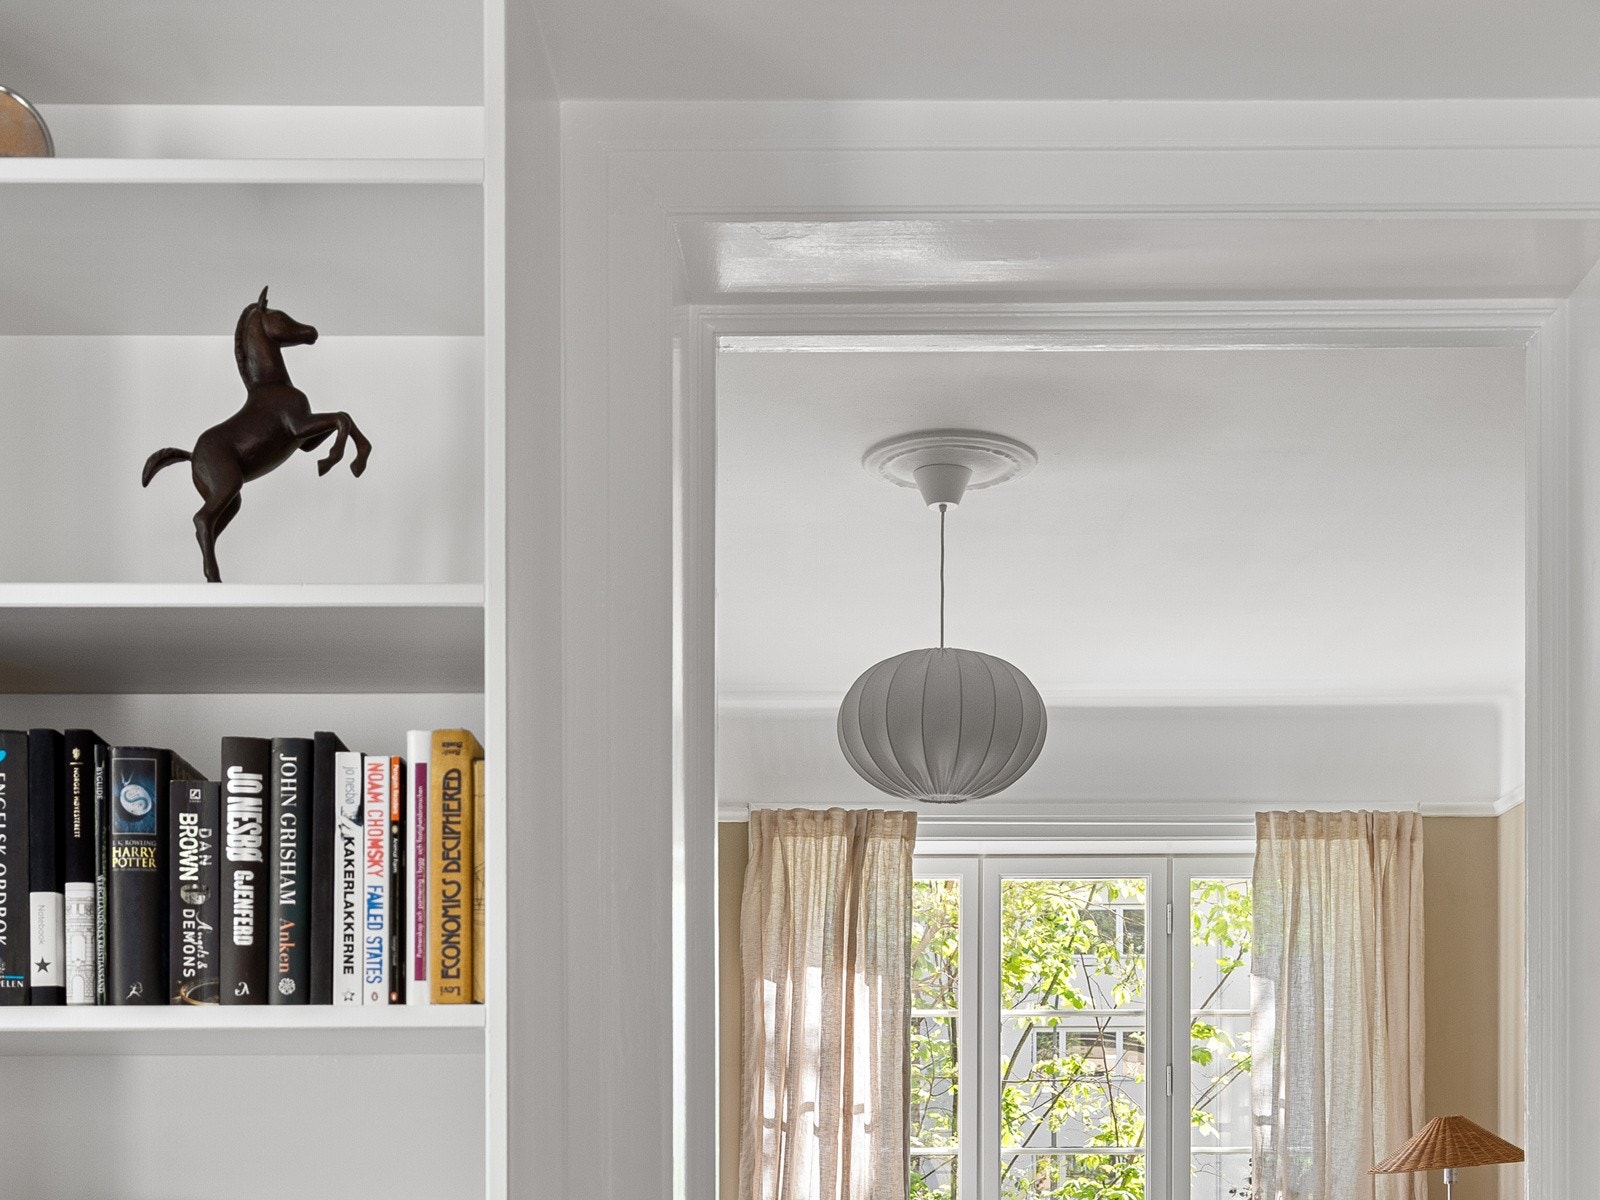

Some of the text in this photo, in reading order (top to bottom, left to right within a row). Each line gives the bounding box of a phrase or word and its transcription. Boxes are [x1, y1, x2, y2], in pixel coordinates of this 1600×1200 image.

[226, 765, 263, 863] JO NESBØ
[342, 766, 356, 805] jo nesbø
[112, 846, 157, 858] HARRY
[178, 812, 199, 881] BROWN
[199, 828, 213, 866] DAN
[367, 763, 385, 878] NOAM CHOMSKY
[112, 857, 157, 868] POTTER
[278, 753, 298, 973] JOHN GRISHAM Anken
[441, 768, 462, 980] ECONOMICS DECIPHERED
[37, 904, 45, 945] Notebook
[193, 911, 213, 958] Angels
[233, 870, 254, 946] GJENFERD
[343, 836, 355, 975] KAKERLAKKERNE
[366, 885, 384, 984] FAILED STATES
[182, 908, 195, 978] DEMONS
[440, 985, 461, 996] Levi
